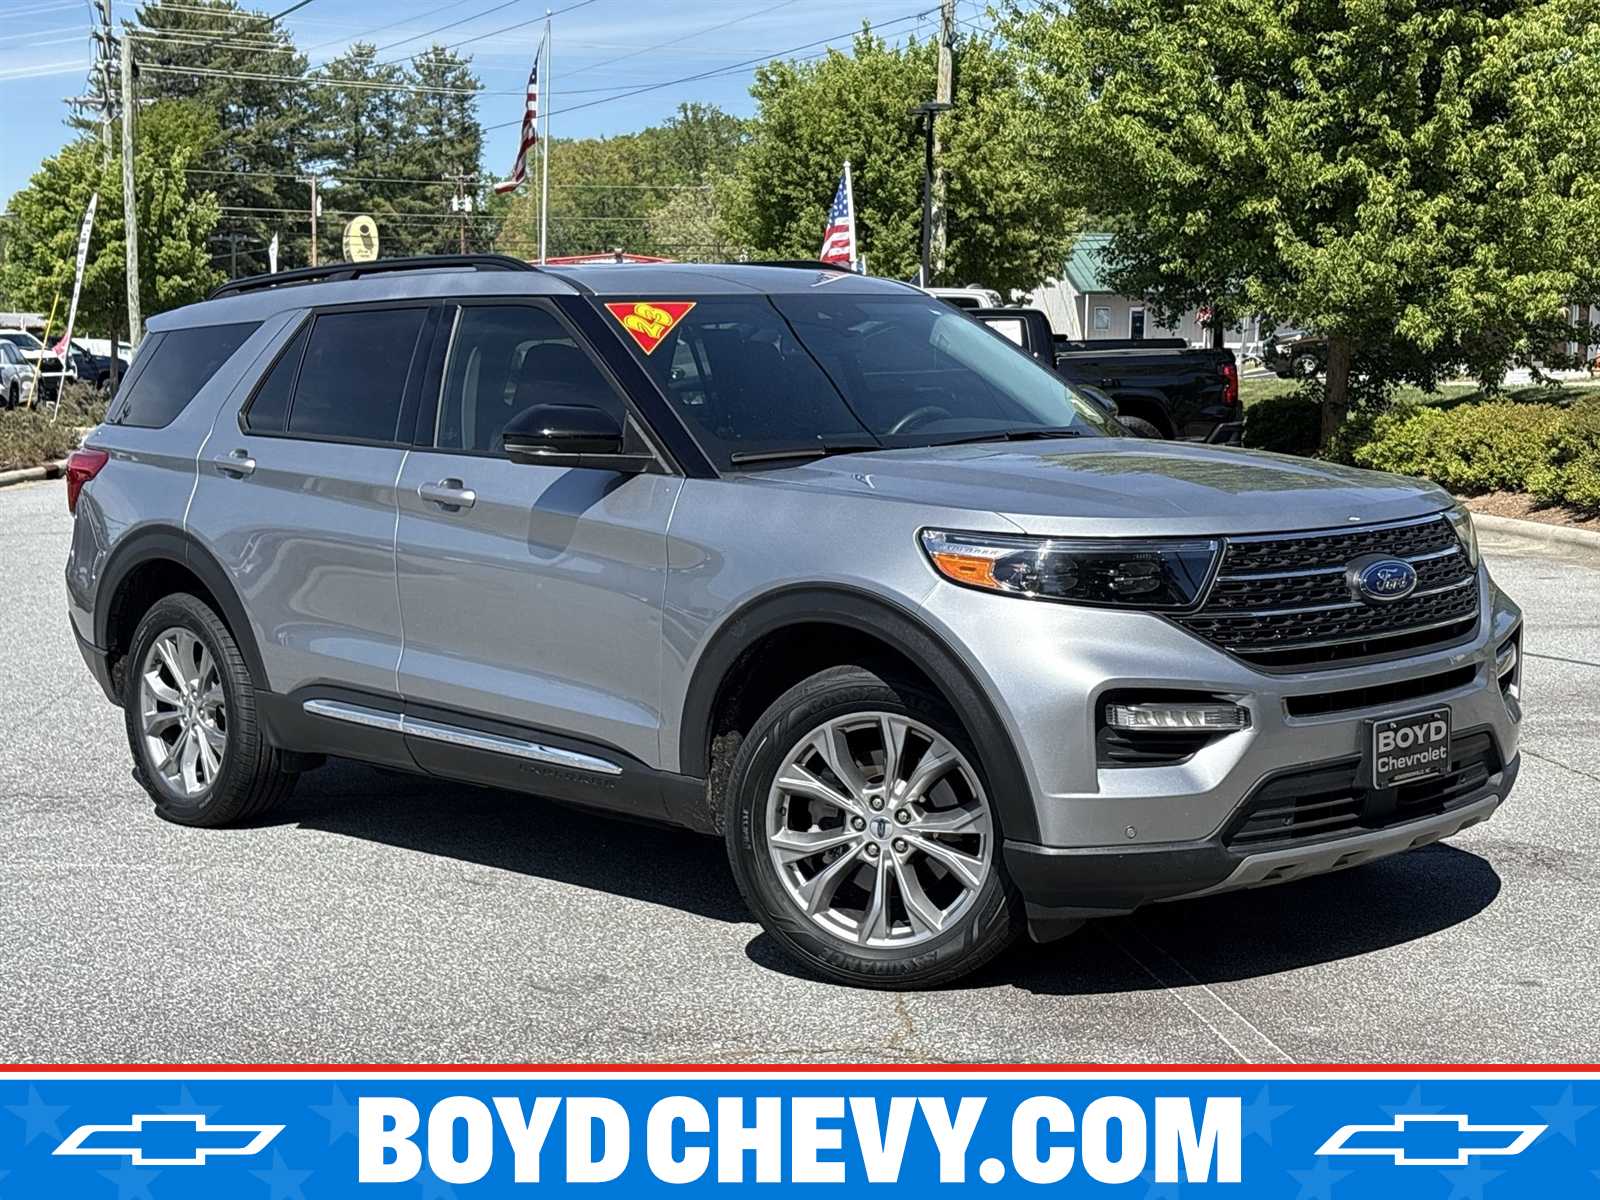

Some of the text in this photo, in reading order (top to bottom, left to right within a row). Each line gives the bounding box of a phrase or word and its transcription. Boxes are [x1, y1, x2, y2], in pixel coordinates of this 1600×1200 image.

[624, 303, 673, 339] 23
[1376, 567, 1408, 592] Ford
[1378, 720, 1447, 753] BOYD
[1377, 746, 1447, 773] Chevrolet
